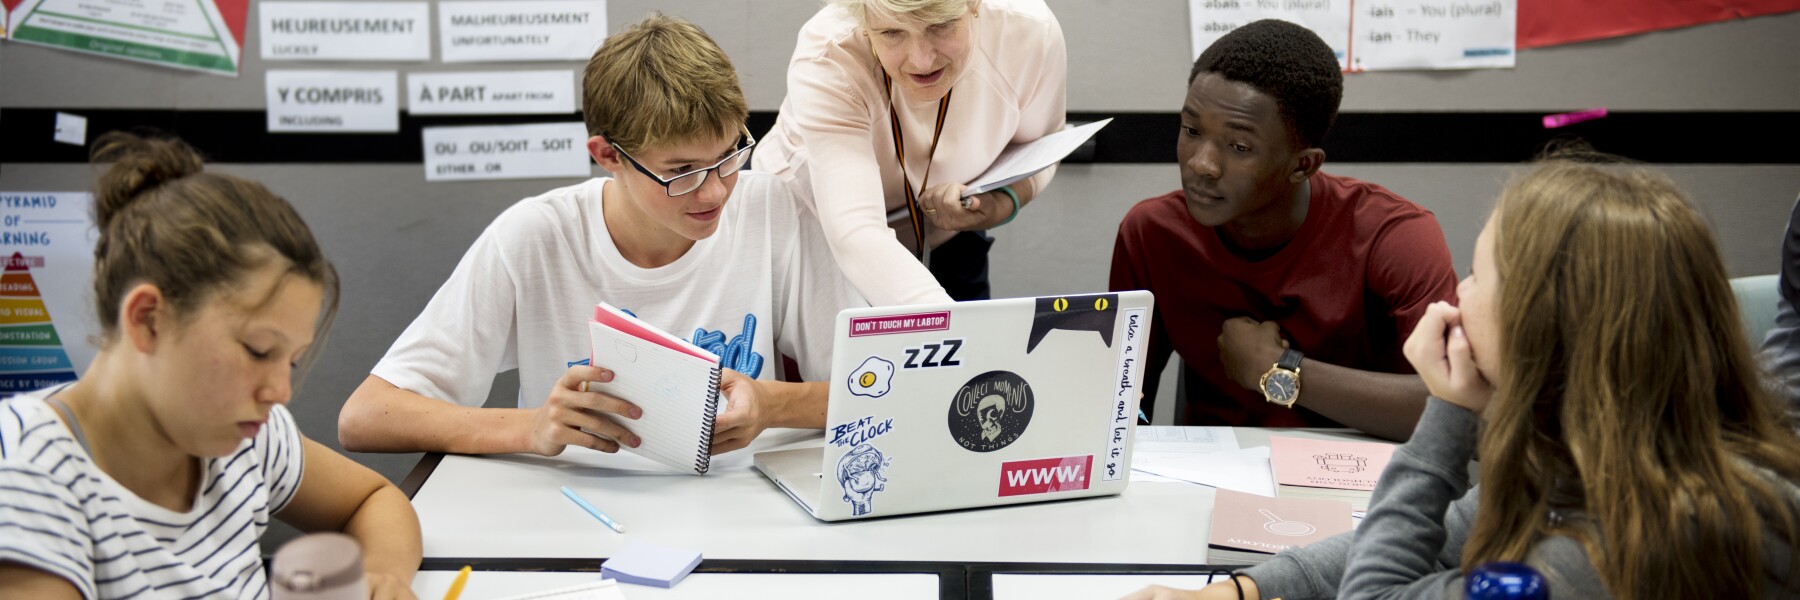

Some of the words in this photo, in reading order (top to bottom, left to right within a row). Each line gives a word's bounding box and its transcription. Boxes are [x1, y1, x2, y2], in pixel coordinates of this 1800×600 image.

[1420, 4, 1447, 18] You
[1451, 2, 1502, 19] (plural)
[271, 18, 415, 34] HEUREUSEMENT
[451, 12, 590, 26] MALHEUREUSEMENT
[452, 35, 550, 47] UNFORTUNATELY
[1406, 28, 1441, 44] They
[272, 45, 318, 55] LUCKILY
[278, 88, 289, 104] Y
[295, 87, 383, 104] COMPRIS
[420, 83, 434, 102] À
[438, 85, 486, 103] PART
[492, 91, 523, 101] APART
[525, 91, 554, 101] FROM
[279, 115, 342, 127] INCLUDING
[0, 195, 57, 208] YRAMID
[4, 214, 21, 227] OF
[0, 231, 50, 246] RNING
[0, 257, 36, 268] ECTURE
[14, 307, 44, 318] VISUAL
[855, 320, 877, 332] DON'T
[879, 318, 901, 330] TOUCH
[903, 318, 915, 328] MY
[917, 316, 945, 327] LABTOP
[1128, 314, 1139, 341] take
[1125, 345, 1133, 354] a
[31, 355, 58, 365] GROUP
[18, 379, 30, 389] BY
[1118, 358, 1134, 397] breath
[956, 381, 989, 417] COLLECT
[993, 379, 1029, 413] MOMENTS
[1115, 400, 1128, 423] and
[829, 415, 874, 444] BEAT
[836, 436, 850, 448] THE
[849, 418, 894, 447] CLOCK
[1113, 427, 1127, 444] let
[959, 436, 977, 450] NOT
[980, 432, 1019, 450] THINGS
[1111, 447, 1122, 458] it
[1106, 462, 1116, 478] go
[1306, 476, 1376, 484] ECHNOLOGY
